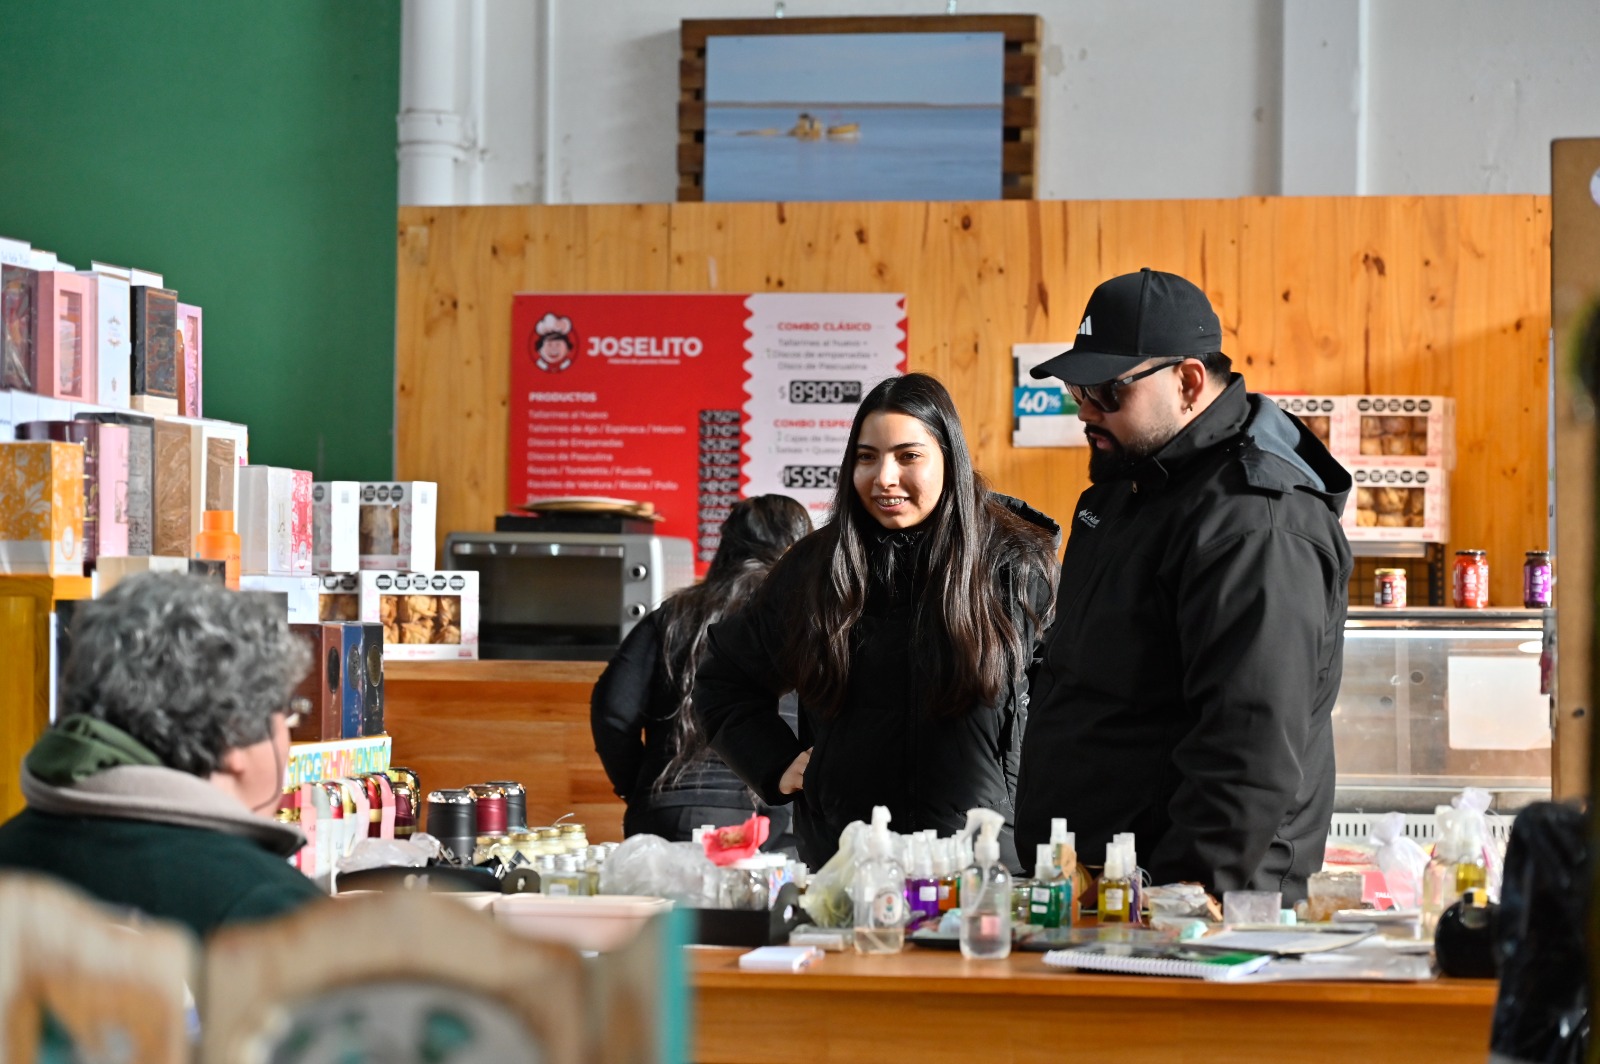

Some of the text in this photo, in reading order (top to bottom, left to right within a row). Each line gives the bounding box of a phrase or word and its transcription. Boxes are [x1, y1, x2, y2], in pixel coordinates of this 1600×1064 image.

[777, 320, 872, 332] COMBO CLÁSICO
[587, 336, 703, 357] JOSELITO
[529, 392, 597, 402] PRODUCTOS
[1018, 390, 1061, 413] 40%
[773, 419, 816, 428] COMBO
